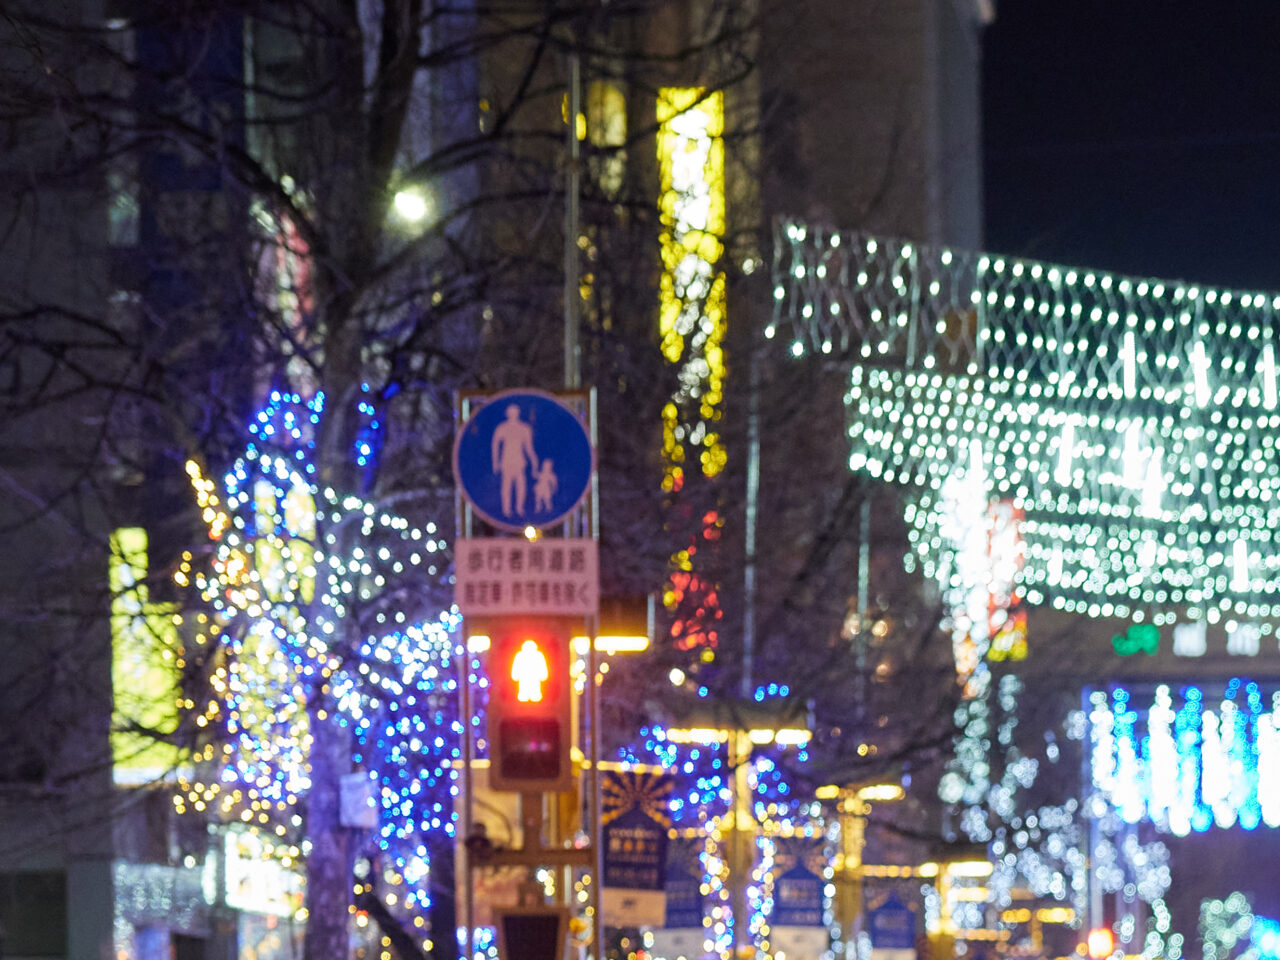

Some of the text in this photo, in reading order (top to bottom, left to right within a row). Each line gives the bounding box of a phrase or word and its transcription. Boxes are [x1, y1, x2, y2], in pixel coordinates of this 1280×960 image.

[468, 547, 586, 574] 歩行者用道路
